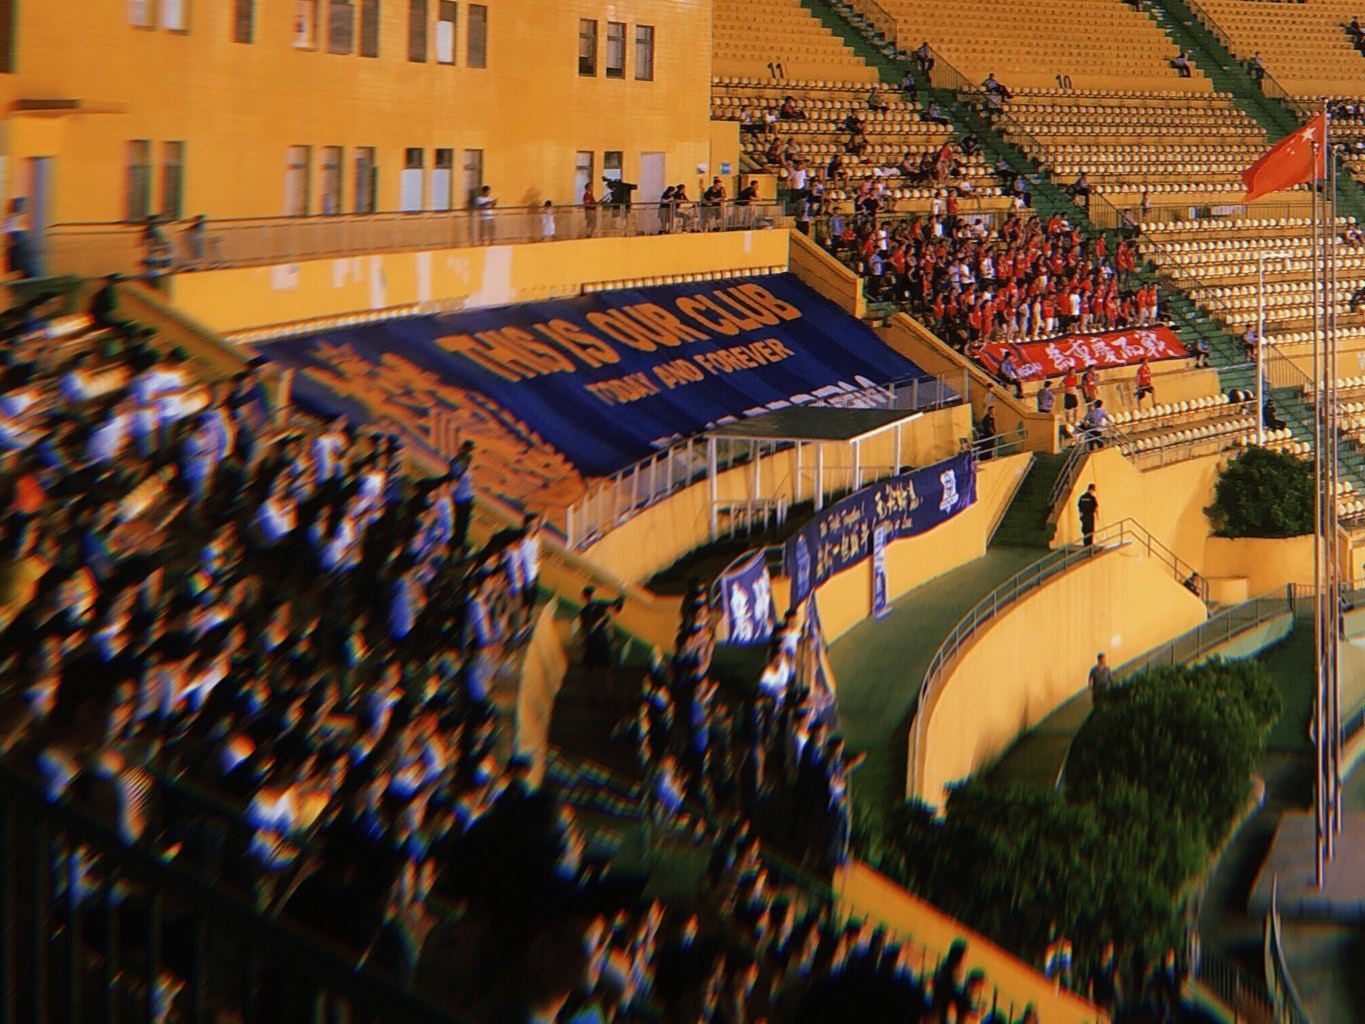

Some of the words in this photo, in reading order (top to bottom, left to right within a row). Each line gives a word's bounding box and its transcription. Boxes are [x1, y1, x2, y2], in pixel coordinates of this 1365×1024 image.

[766, 61, 785, 79] 11
[1055, 74, 1072, 89] 10
[434, 326, 577, 383] THIS
[535, 318, 621, 368] IS
[586, 302, 712, 353] OUR
[675, 283, 802, 337] CLUB
[584, 370, 662, 406] TODAY
[652, 357, 705, 390] AND
[694, 337, 795, 376] FOREVER
